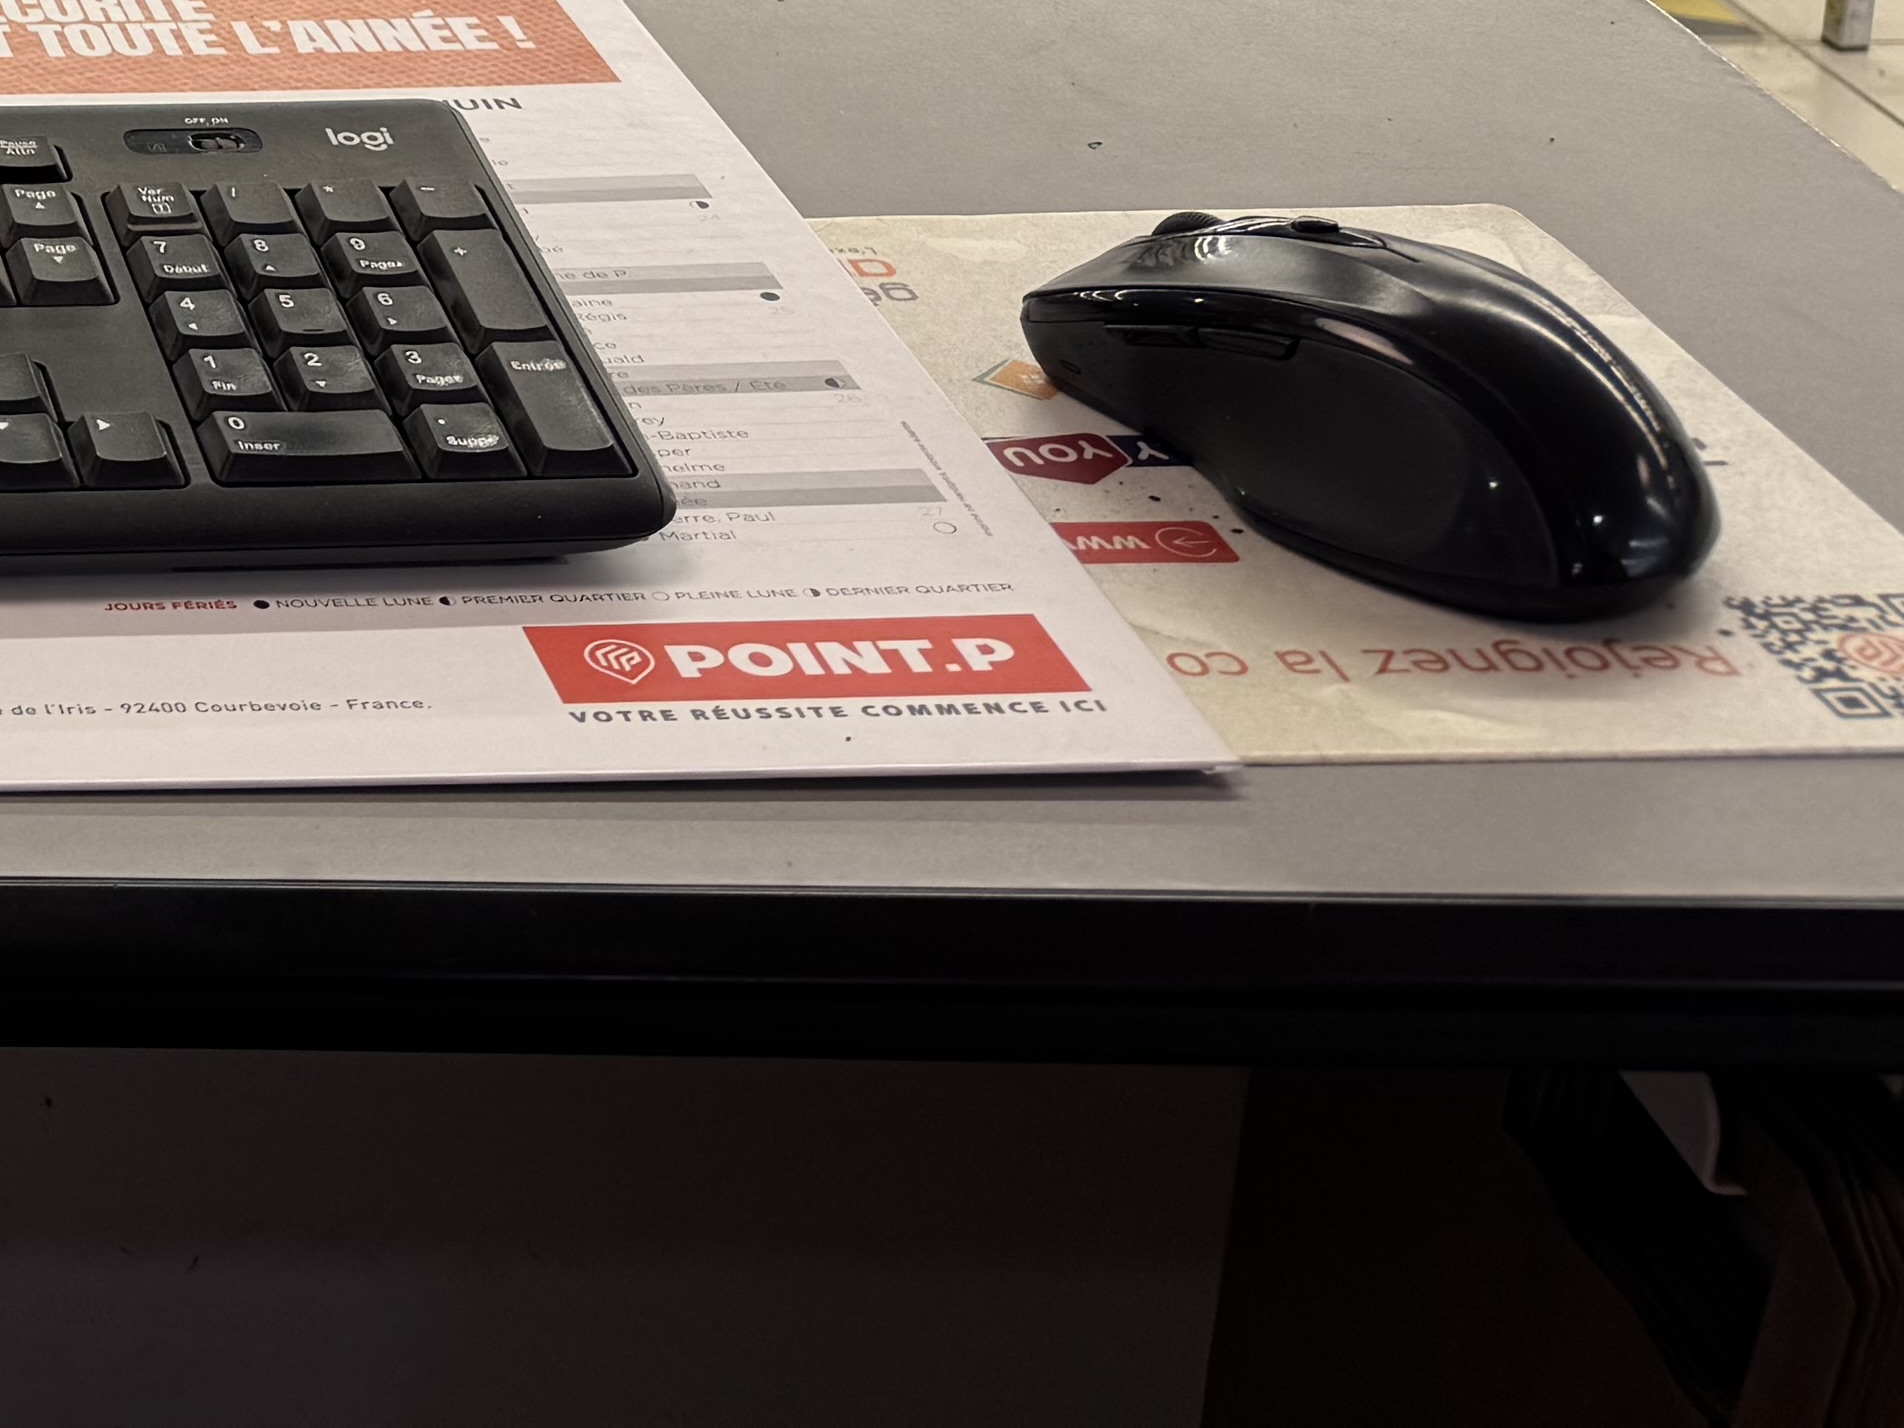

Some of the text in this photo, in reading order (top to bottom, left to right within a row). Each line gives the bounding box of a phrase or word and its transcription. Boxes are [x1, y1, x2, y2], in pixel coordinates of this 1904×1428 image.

[26, 21, 228, 58] TOUTE
[232, 10, 501, 55] L'ANNÉE
[496, 15, 536, 48] !
[325, 126, 395, 153] logi
[663, 637, 1016, 681] POINT.P
[1275, 647, 1351, 683] la
[1377, 641, 1742, 682] Rejoignez
[11, 703, 37, 716] de
[44, 702, 96, 715] l'Iris
[120, 701, 187, 714] 92400
[195, 699, 322, 713] Courbevoie
[347, 697, 433, 711] France.
[568, 699, 1108, 724] VOTRE RÉUSSITE COMMENCE ICI
